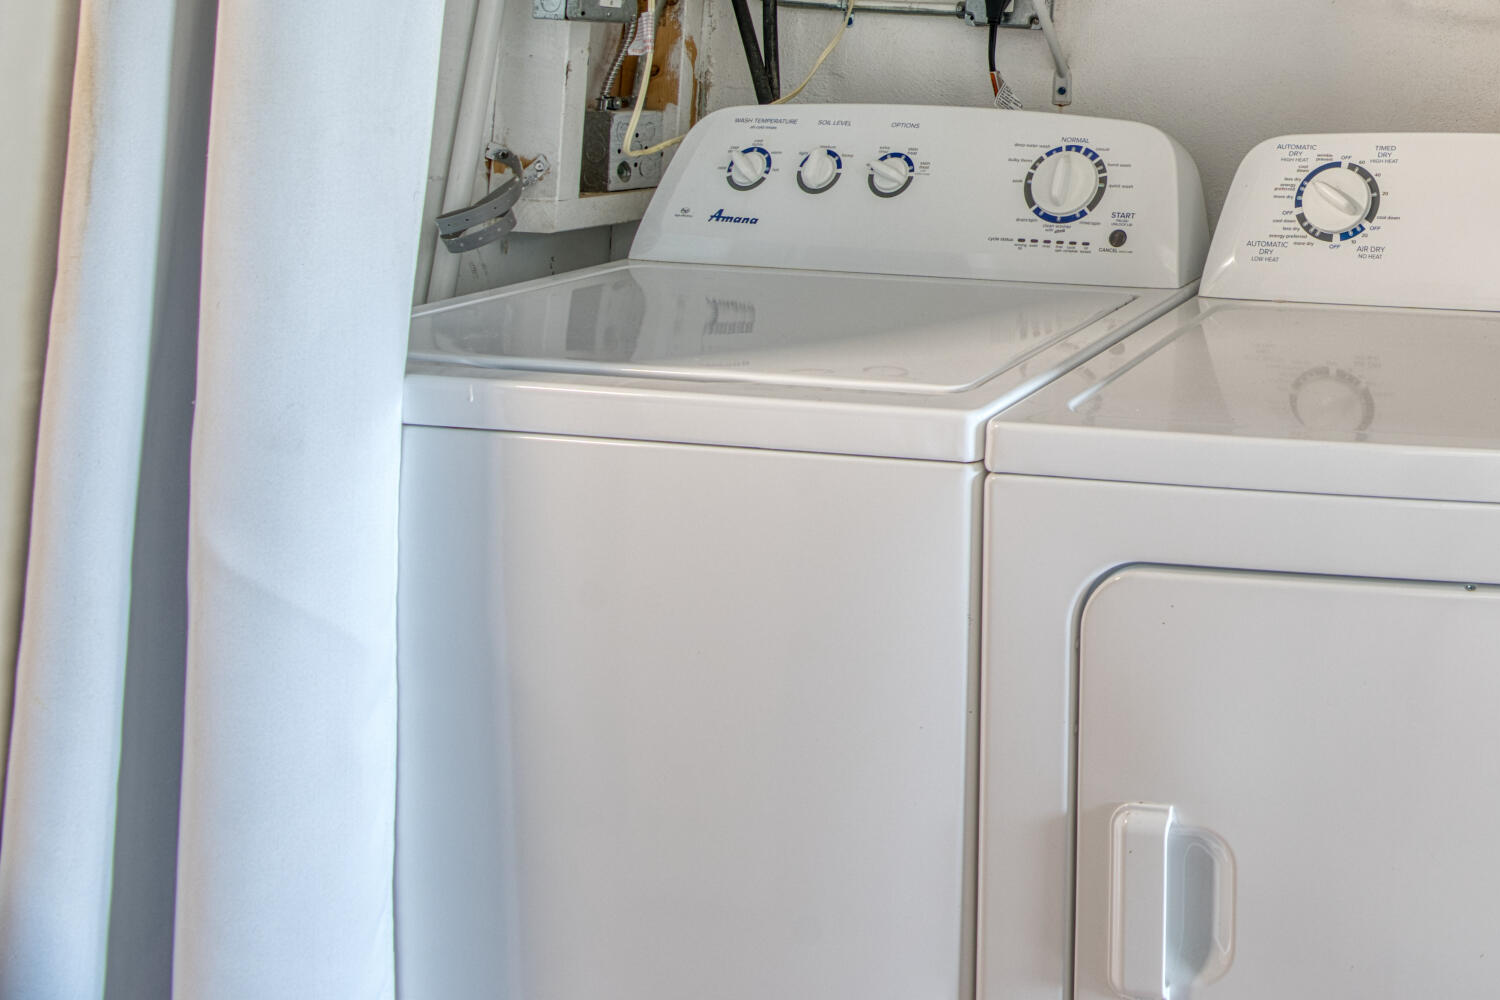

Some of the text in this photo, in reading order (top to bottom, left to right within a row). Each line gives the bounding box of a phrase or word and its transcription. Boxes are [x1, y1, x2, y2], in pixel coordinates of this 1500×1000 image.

[1061, 136, 1089, 144] NORMAL
[708, 208, 760, 225] Amana
[1111, 211, 1136, 219] START
[1246, 240, 1289, 248] AUTOMATIC
